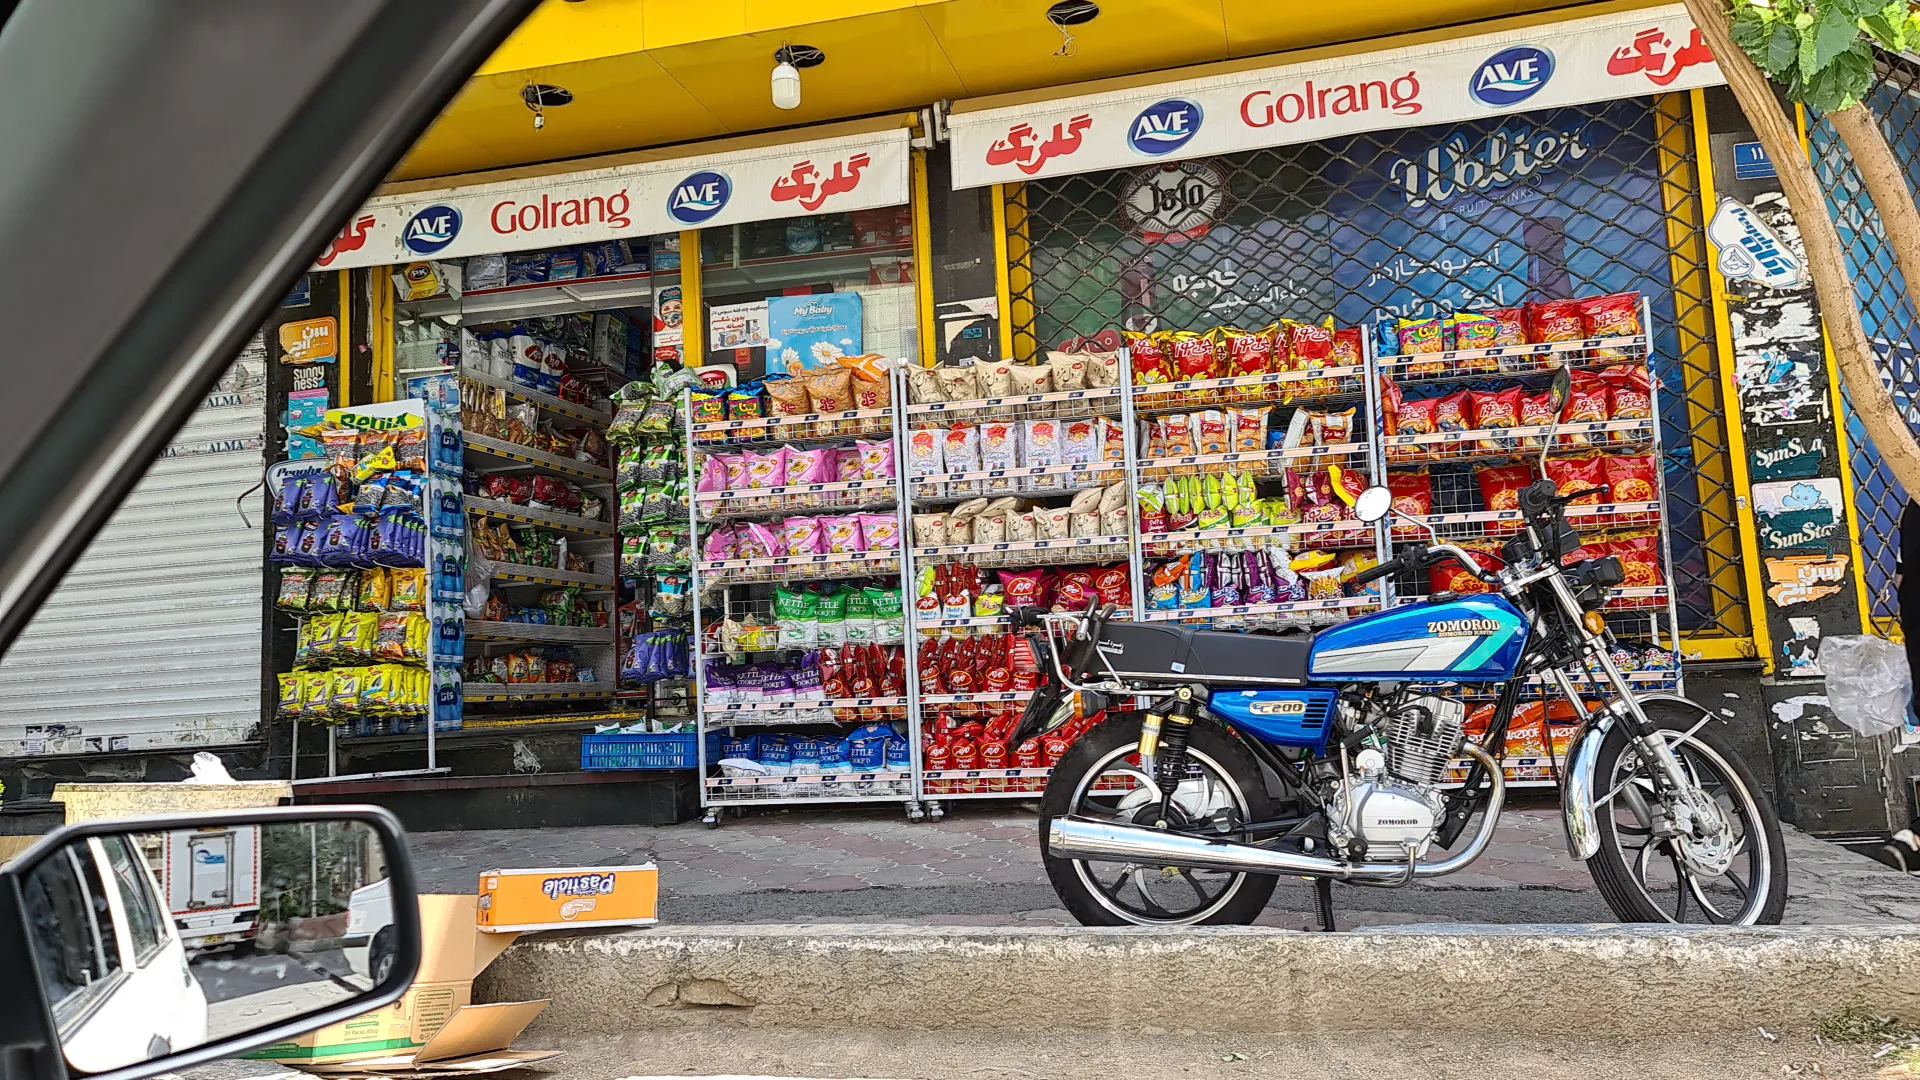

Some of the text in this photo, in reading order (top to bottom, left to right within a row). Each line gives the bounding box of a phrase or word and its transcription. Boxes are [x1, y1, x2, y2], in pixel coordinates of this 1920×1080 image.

[1606, 27, 1716, 86] لرنگ
[1239, 71, 1424, 128] Golrang
[986, 113, 1094, 175] گلرنگ
[770, 152, 871, 211] گلرنگ
[490, 188, 632, 234] Golrang
[316, 213, 376, 267] گلر
[793, 303, 833, 317] My Baby
[206, 394, 243, 408] ALMA
[158, 446, 177, 458] MA
[208, 439, 244, 454] ALMA
[779, 598, 810, 609] KETTLE
[818, 601, 840, 609] TTLE
[847, 597, 869, 605] ETTLE
[872, 596, 902, 607] KETTL
[877, 605, 899, 613] COOKE
[1427, 618, 1501, 633] ZOMOROD
[736, 672, 761, 680] KETTL
[761, 672, 788, 683] ETTLE
[791, 669, 819, 681] KETTL
[763, 681, 786, 689] OOKED
[795, 677, 820, 686] OOKED
[1550, 726, 1580, 738] AZPO
[792, 742, 817, 750] KETT
[818, 745, 843, 755] ETTLE
[850, 747, 875, 756] ETTLE
[818, 753, 840, 762] OOKED
[1377, 818, 1419, 826] ZOMOROD
